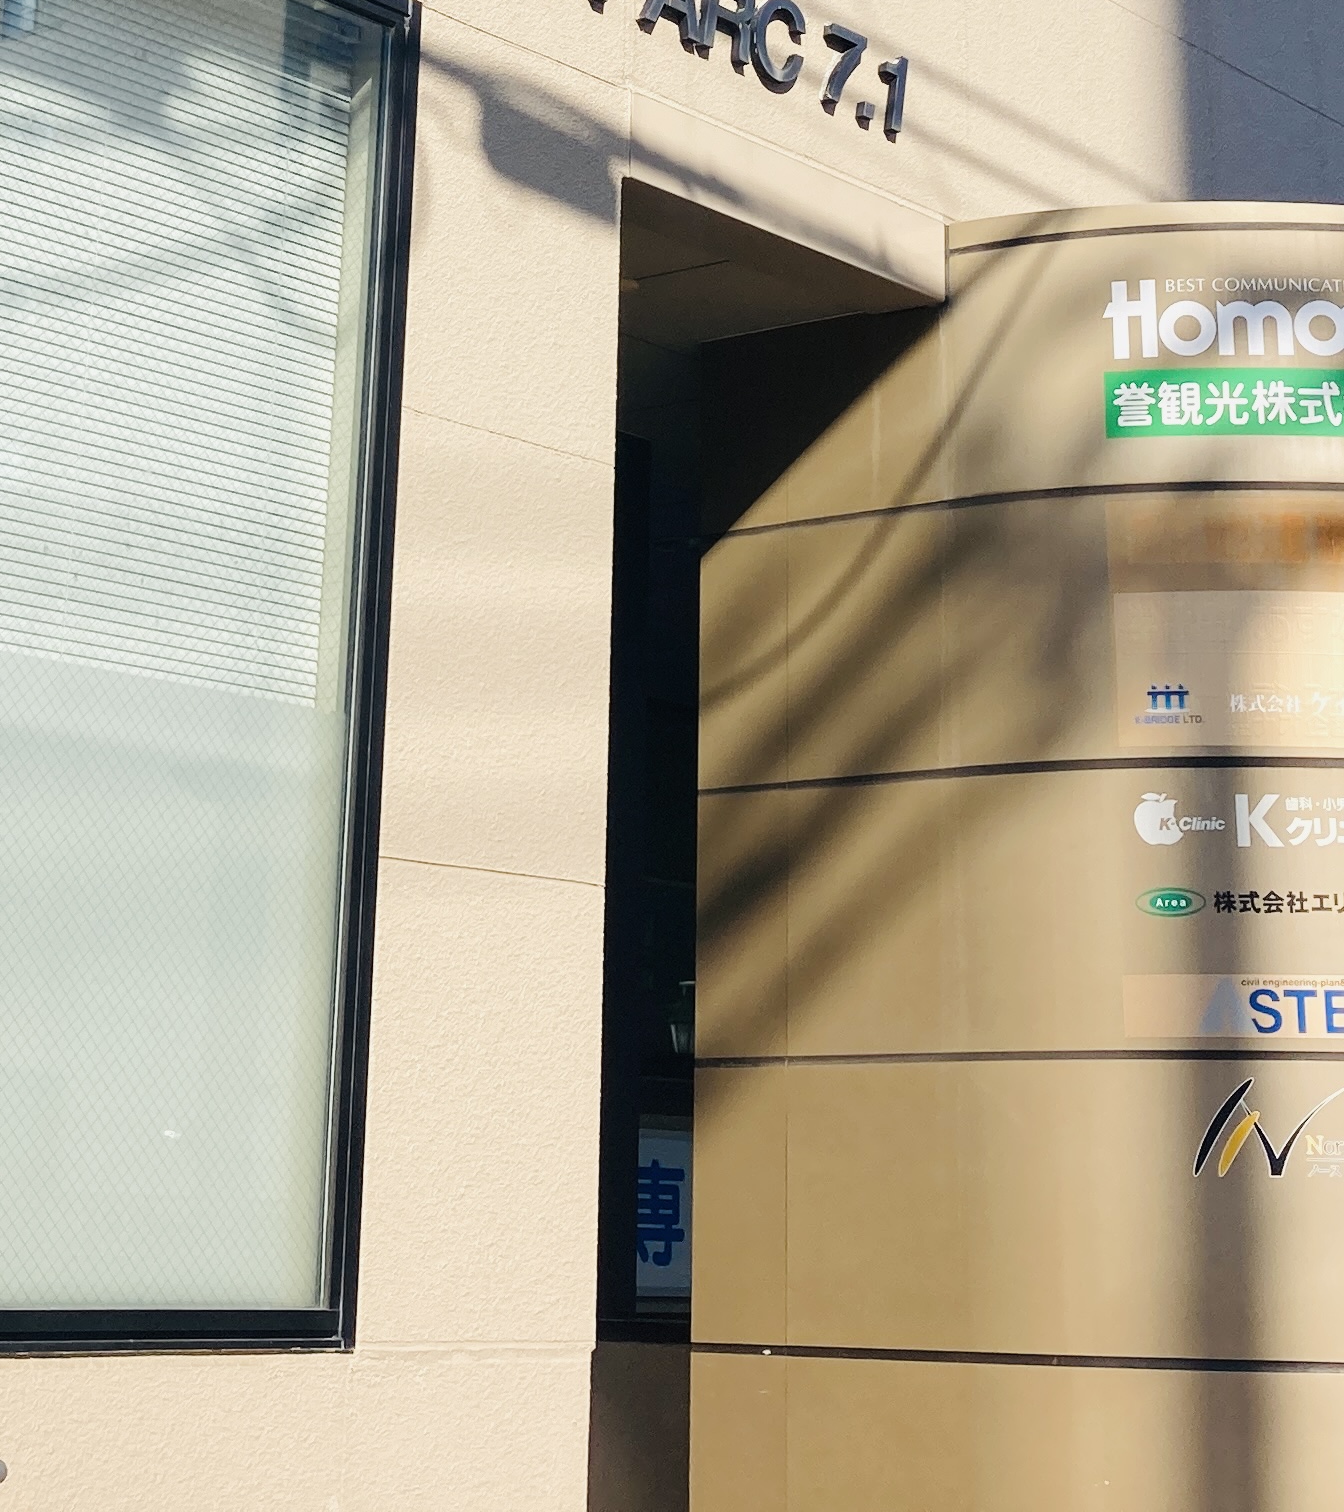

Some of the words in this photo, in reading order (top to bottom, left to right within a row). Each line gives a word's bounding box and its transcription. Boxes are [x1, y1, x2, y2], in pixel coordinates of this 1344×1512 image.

[820, 22, 910, 144] 7.1
[1165, 278, 1206, 293] BEST
[1229, 693, 1301, 714] 株式会社
[1178, 816, 1226, 832] Clinic
[1155, 897, 1188, 909] Area
